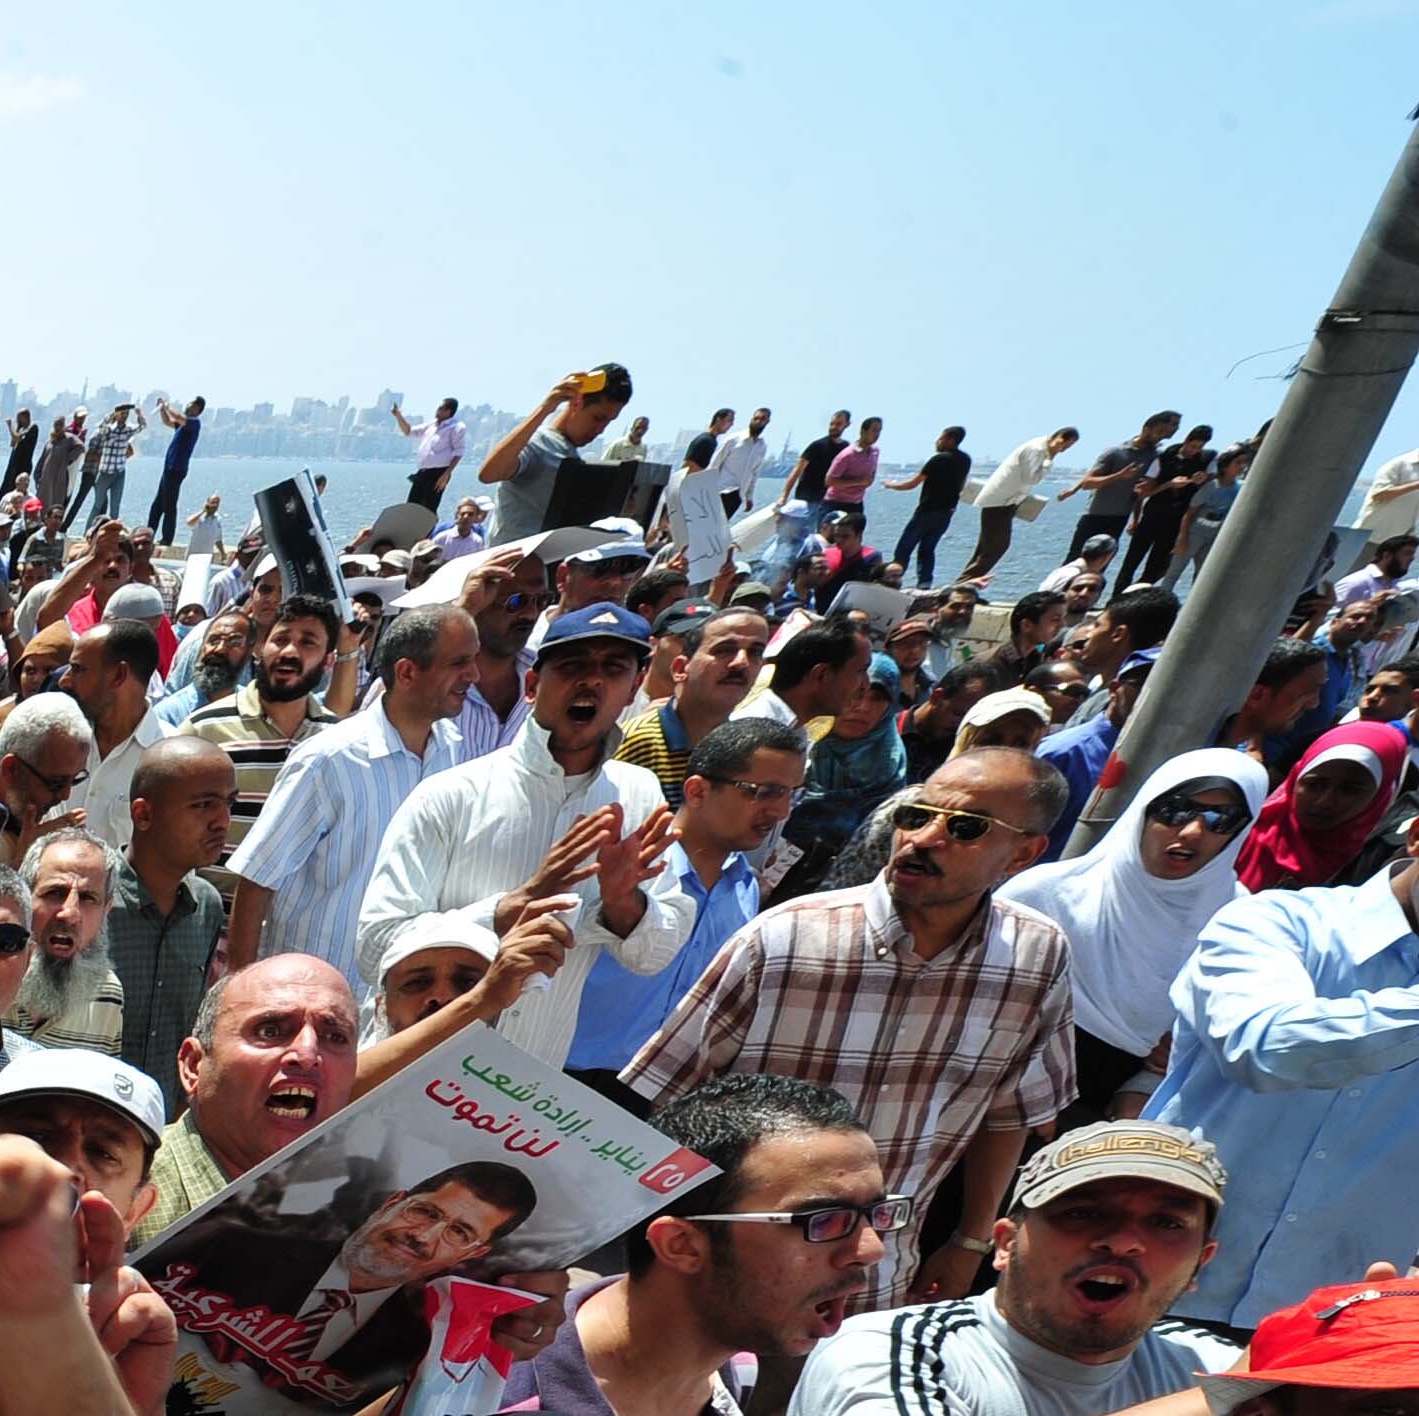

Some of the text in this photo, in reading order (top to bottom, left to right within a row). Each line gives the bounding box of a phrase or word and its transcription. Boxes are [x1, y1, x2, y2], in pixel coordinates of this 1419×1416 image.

[461, 1054, 542, 1103] شعب
[425, 1078, 561, 1158] لن تموت
[646, 1162, 686, 1188] ٢٥
